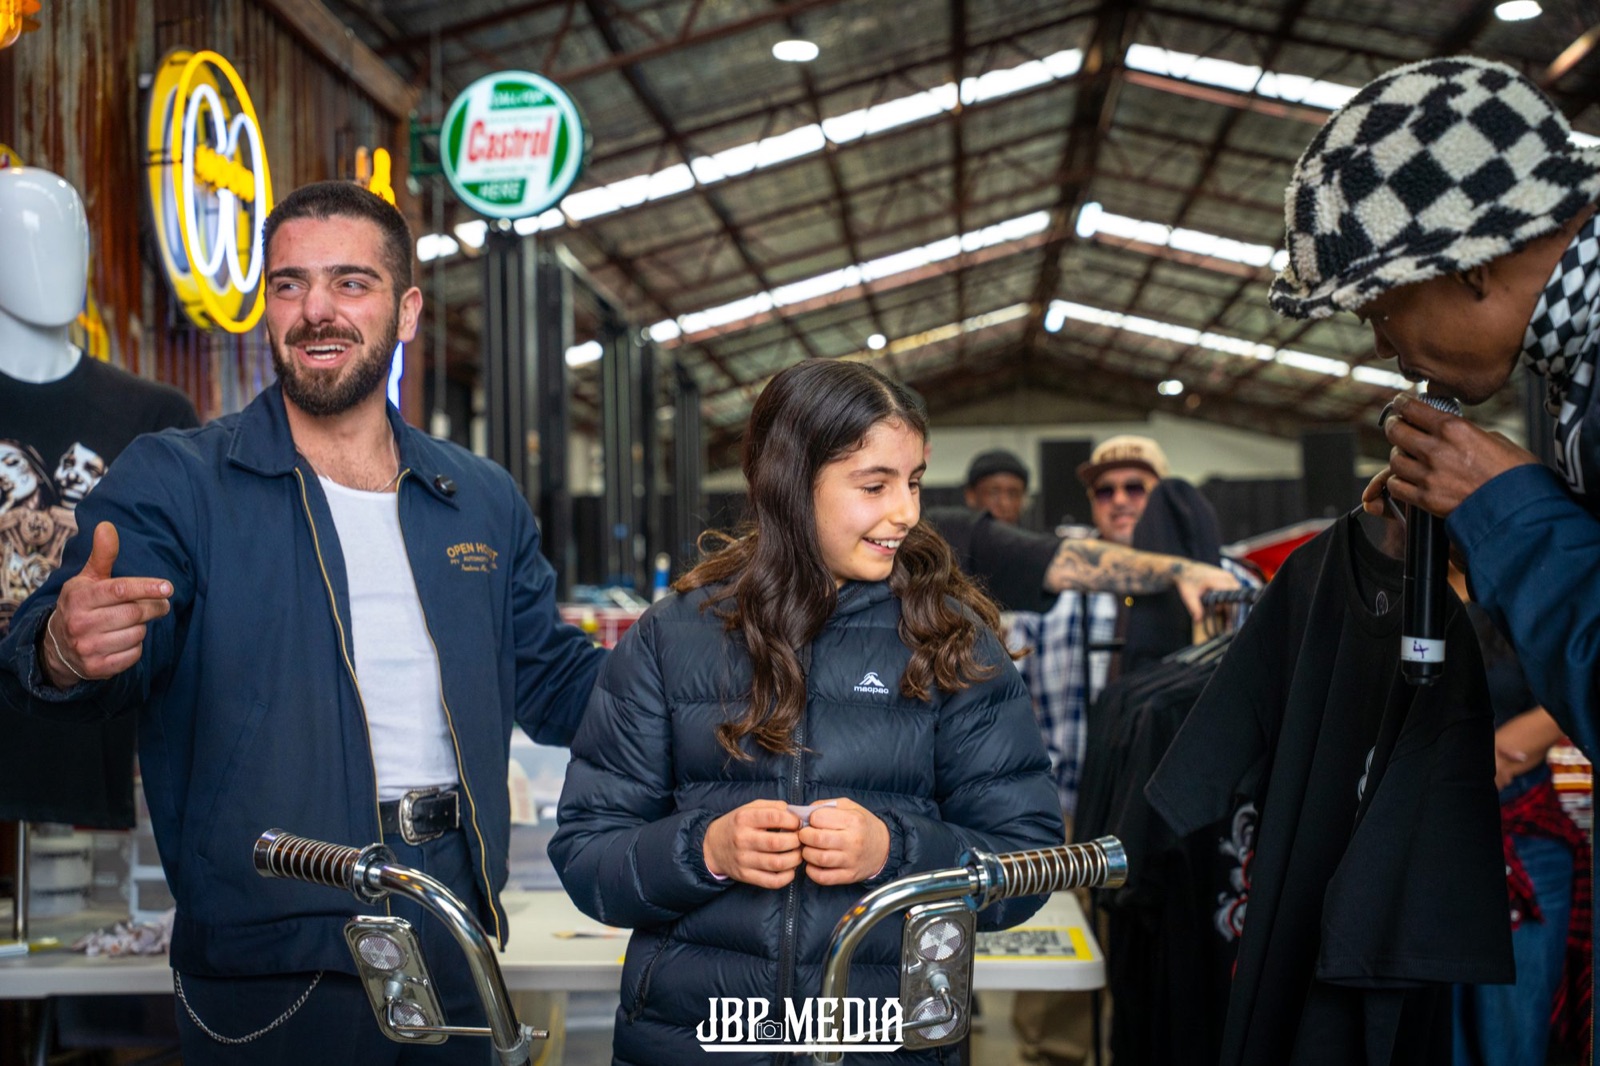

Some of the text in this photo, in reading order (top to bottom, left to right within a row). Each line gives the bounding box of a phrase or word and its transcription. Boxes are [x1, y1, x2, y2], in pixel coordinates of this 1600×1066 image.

[468, 115, 553, 162] Castrol
[479, 182, 520, 200] HERE
[446, 542, 475, 557] OPEN
[1413, 640, 1429, 659] 4
